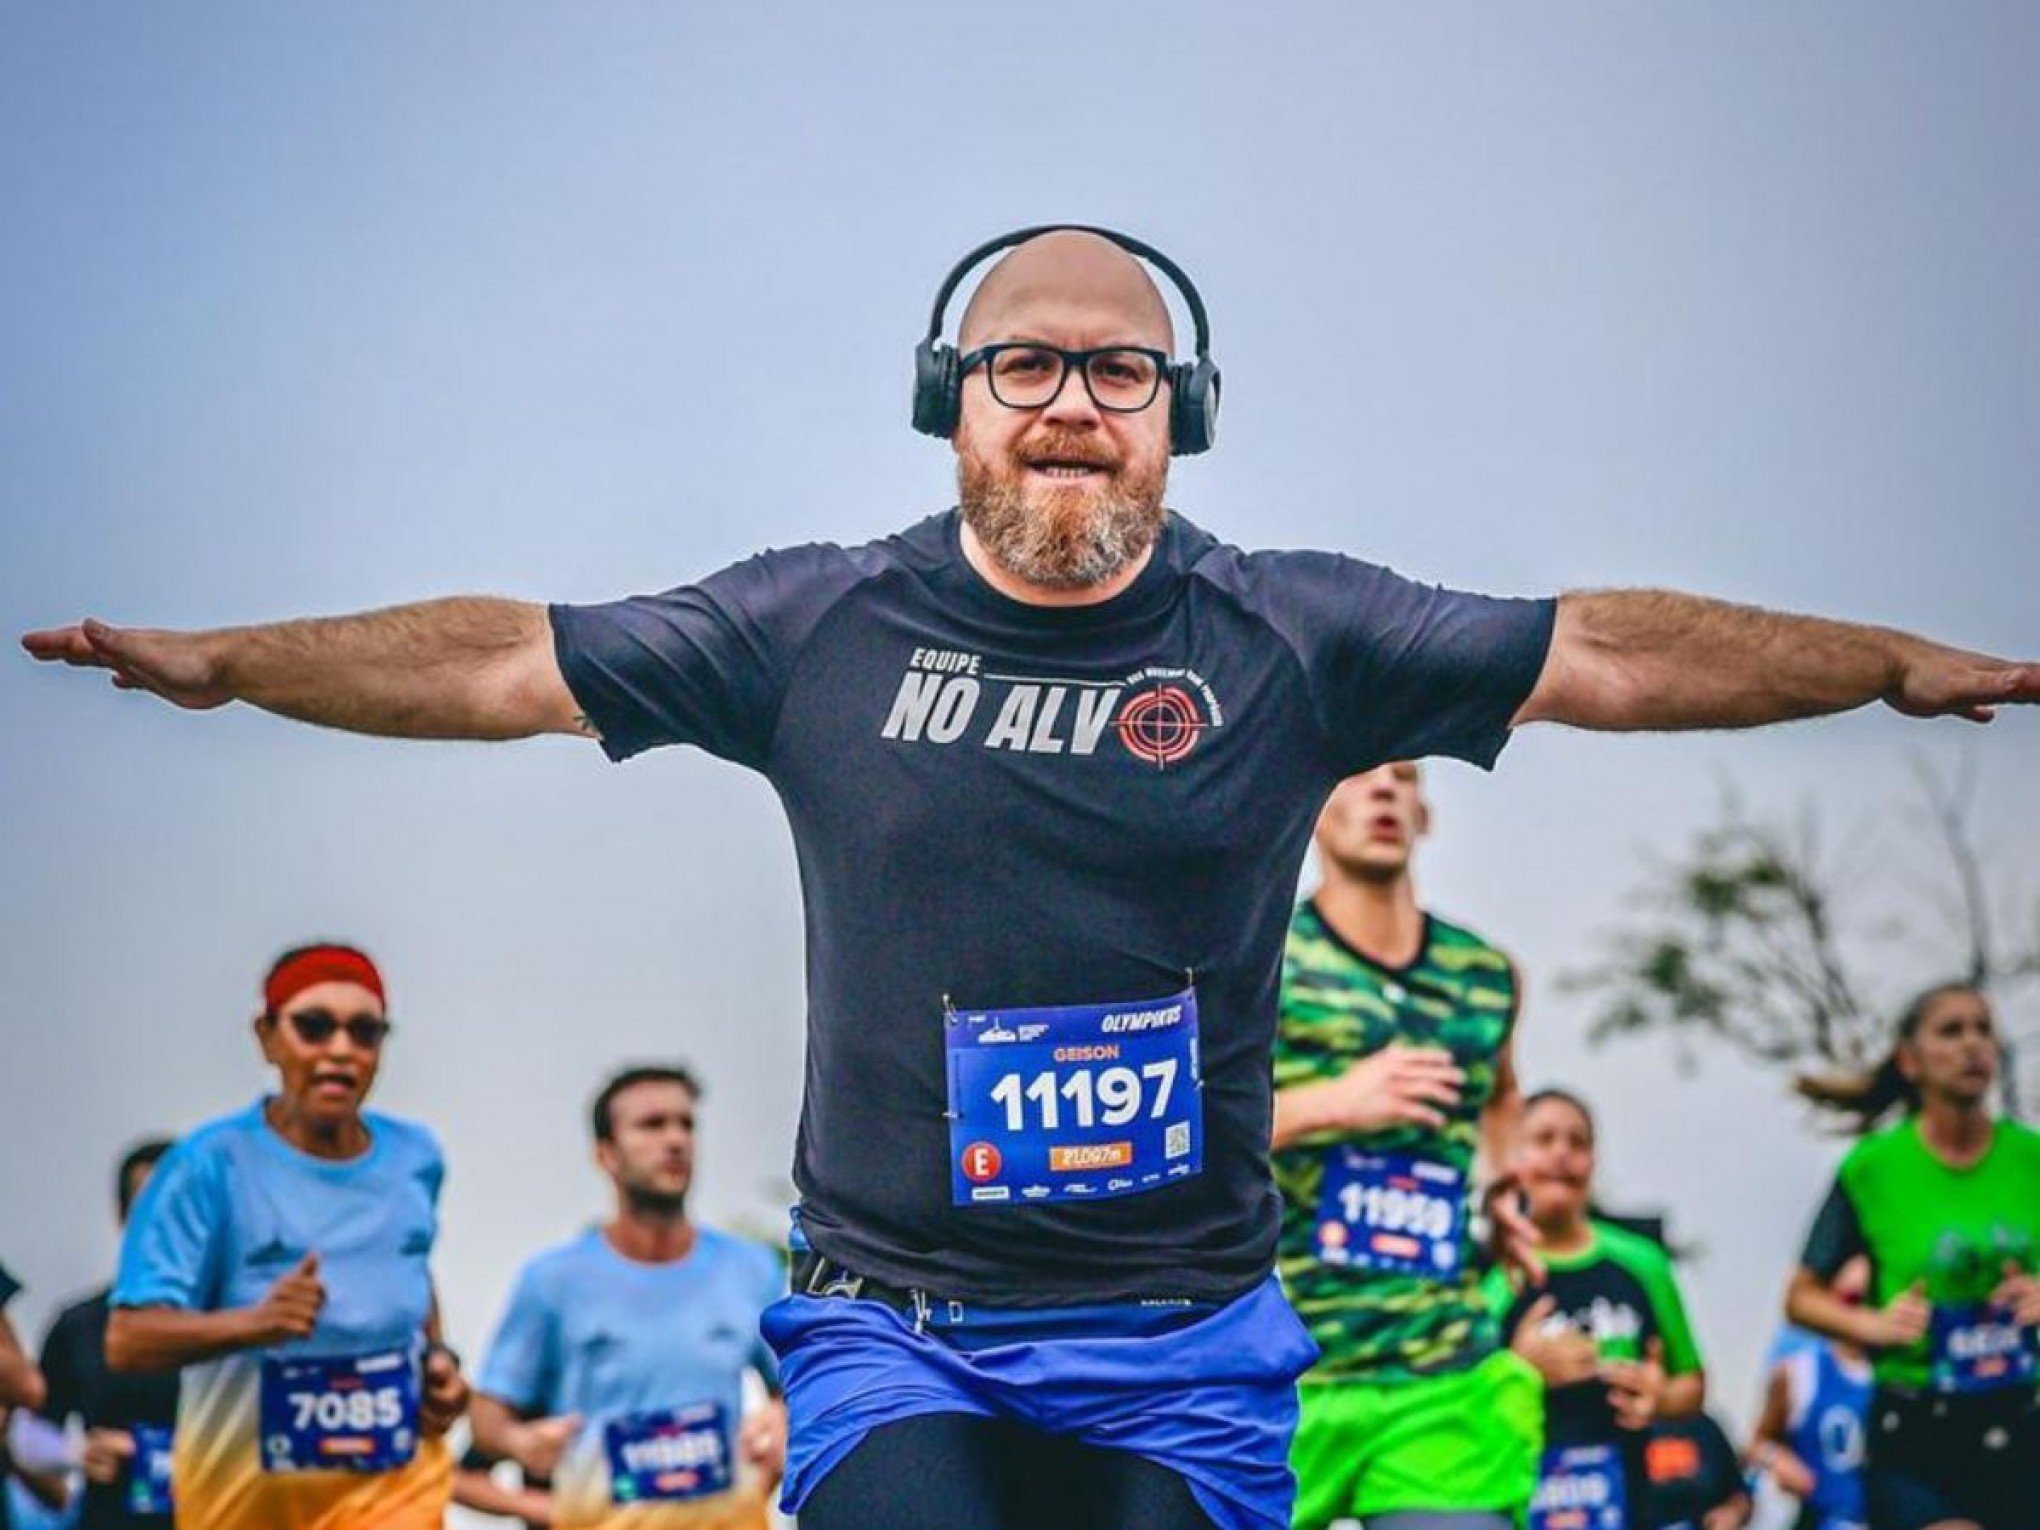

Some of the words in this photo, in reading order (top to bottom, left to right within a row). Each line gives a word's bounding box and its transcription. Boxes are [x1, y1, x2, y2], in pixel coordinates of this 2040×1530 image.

[908, 647, 981, 674] EQUIPE
[881, 671, 981, 744] NO
[1102, 1005, 1182, 1033] OLYMPIKUS
[1054, 1044, 1119, 1062] GEISON
[991, 1058, 1178, 1131] 11197
[975, 1148, 990, 1175] E
[287, 1384, 402, 1430] 7085
